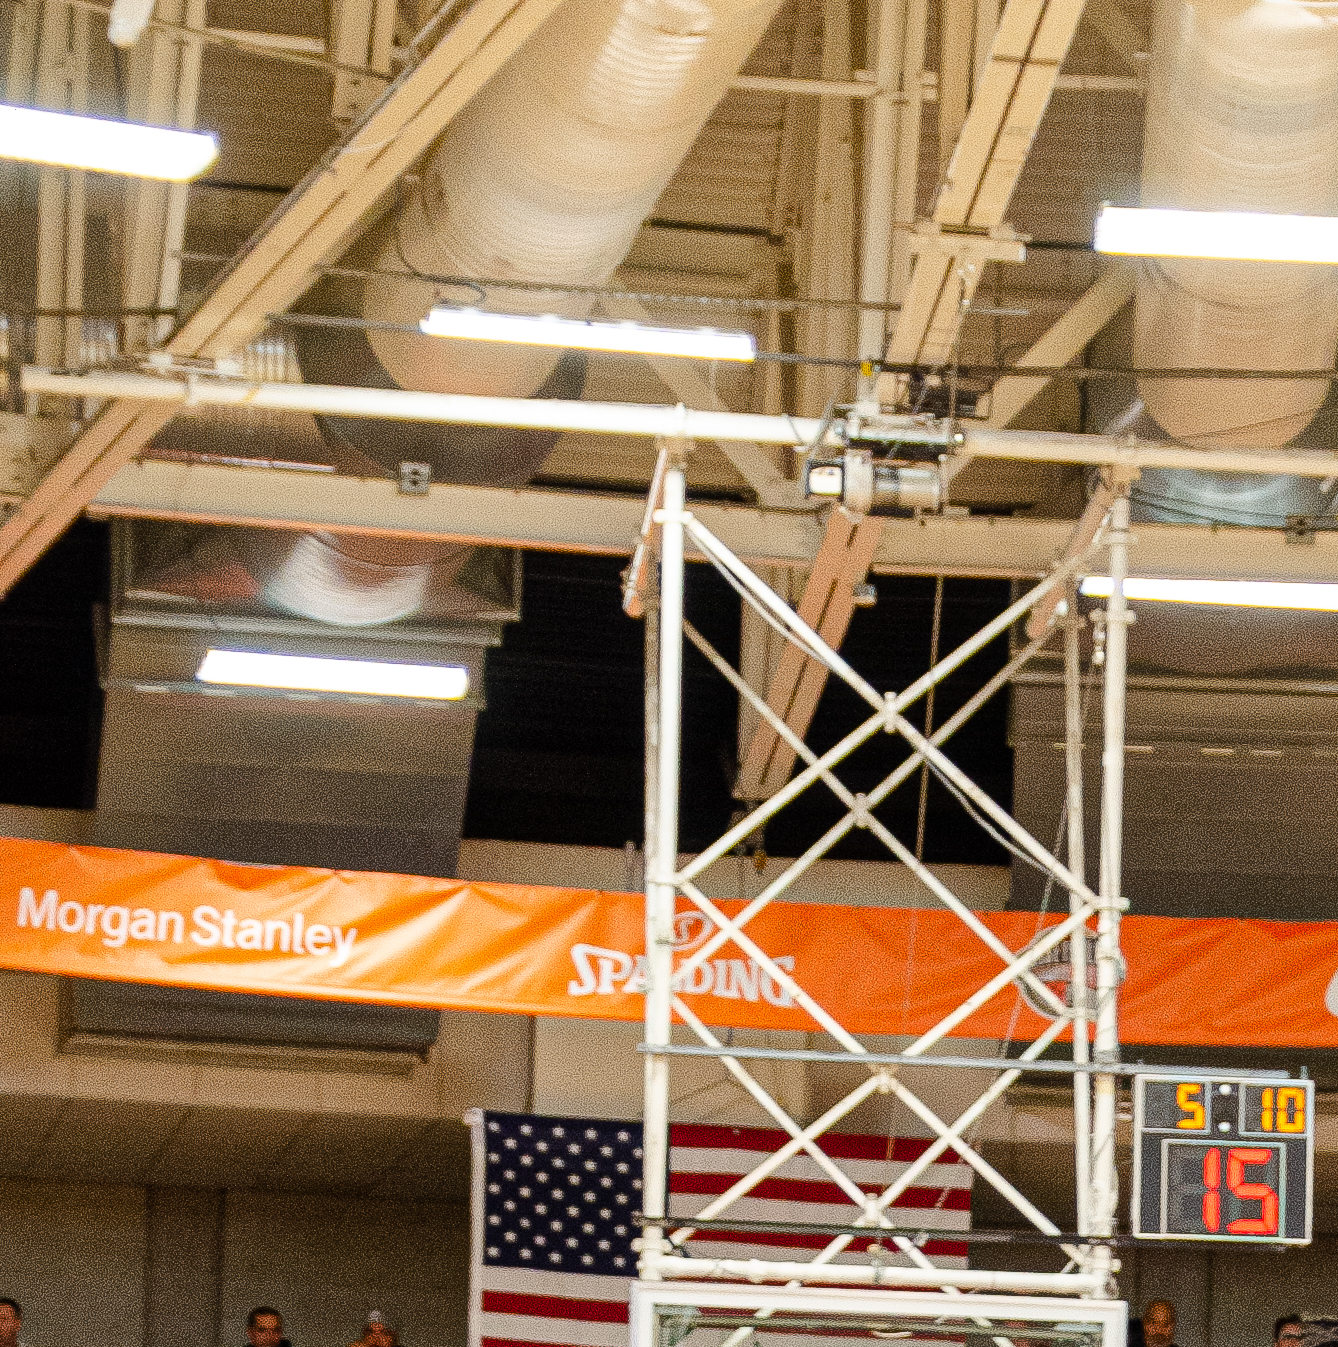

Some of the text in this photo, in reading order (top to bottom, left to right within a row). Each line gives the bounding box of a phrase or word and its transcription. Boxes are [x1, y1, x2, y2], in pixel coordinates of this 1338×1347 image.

[17, 886, 357, 967] Morgan Stanley
[567, 942, 796, 1009] SPADING
[1202, 1146, 1279, 1236] 15
